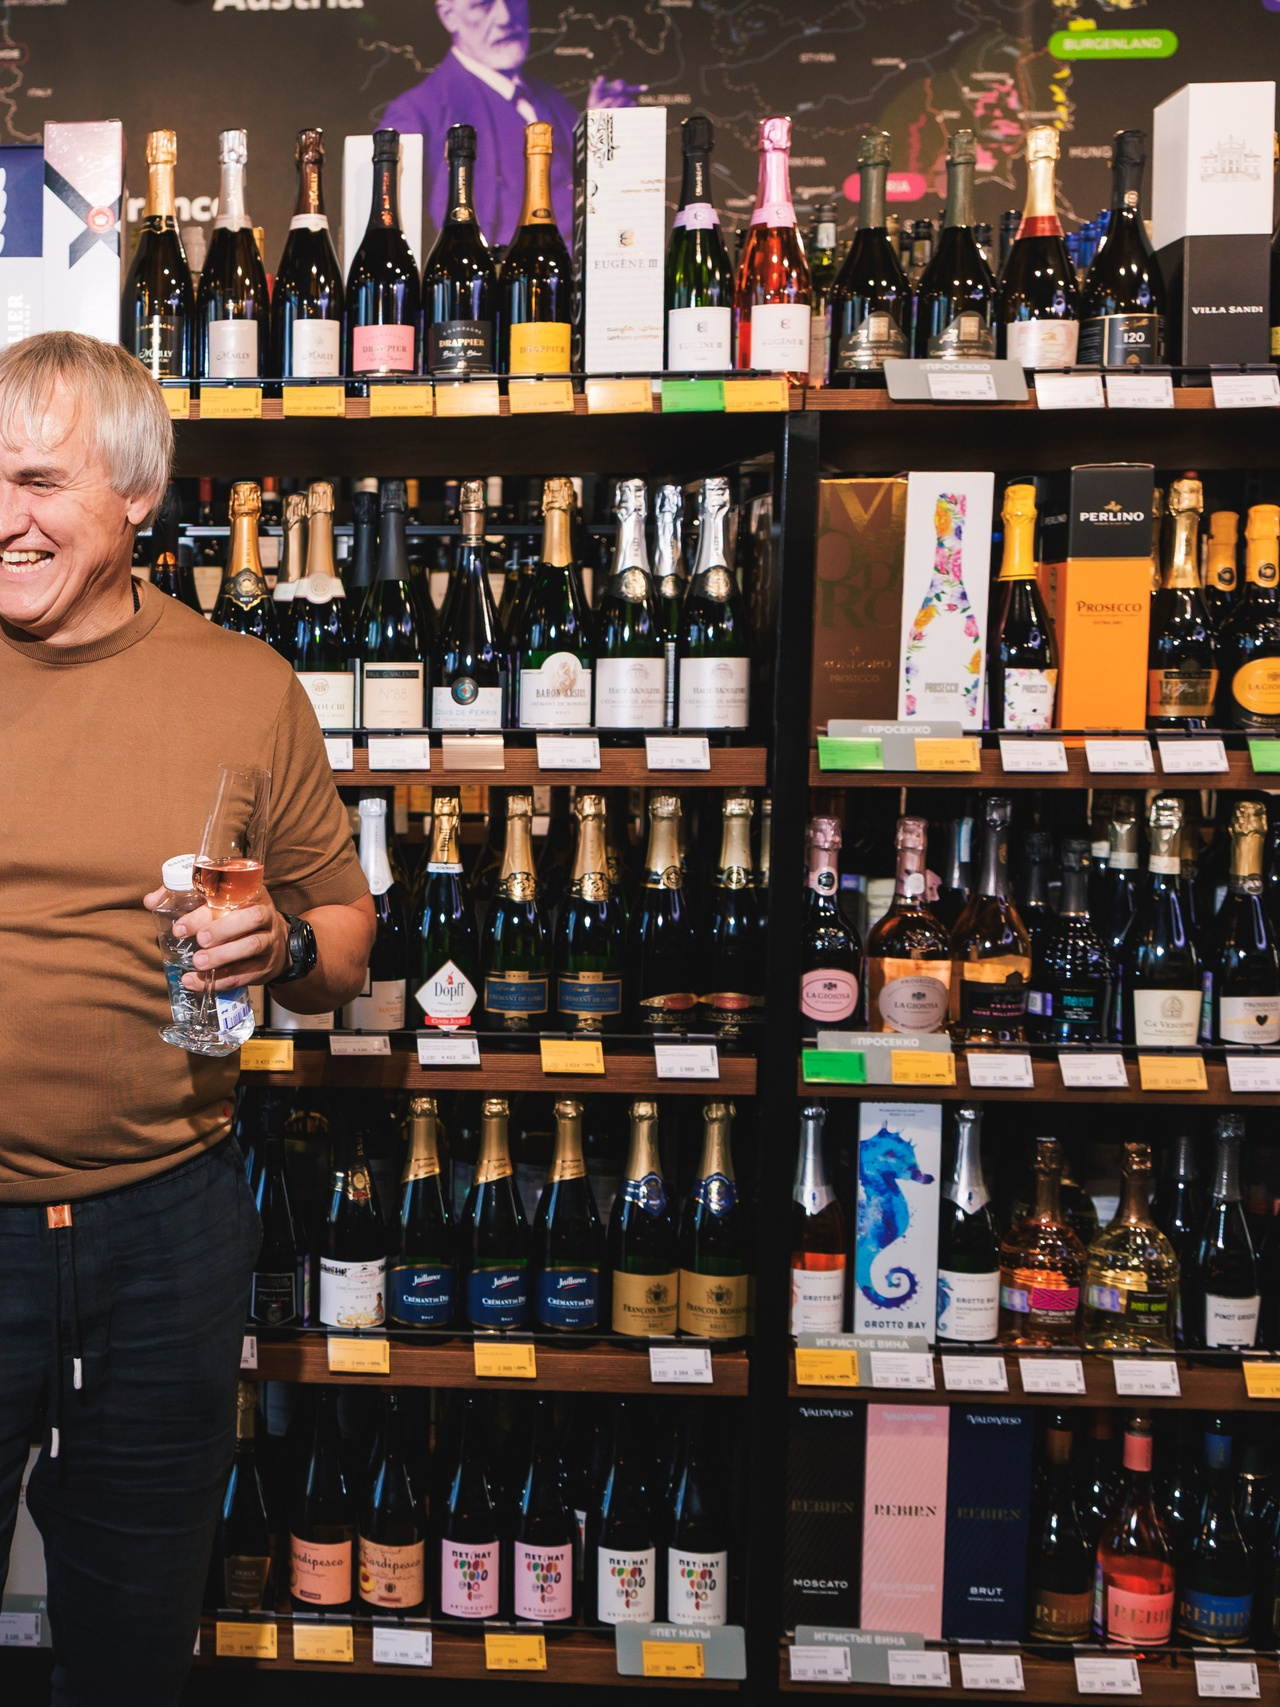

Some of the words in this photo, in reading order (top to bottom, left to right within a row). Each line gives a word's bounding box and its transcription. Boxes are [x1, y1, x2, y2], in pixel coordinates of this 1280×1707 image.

[1062, 36, 1163, 52] BURGENLAND
[594, 257, 645, 270] EUGÈNE
[1191, 306, 1226, 314] VILLA
[1228, 305, 1264, 314] SANDI
[1123, 331, 1146, 343] 120
[362, 344, 407, 353] DRAPPIER
[439, 339, 485, 347] DRAPPIER
[1079, 511, 1145, 522] PERLINO
[1076, 600, 1142, 612] PROSECCO
[536, 688, 562, 698] BARON
[434, 981, 466, 1001] Dopff
[803, 1294, 830, 1302] GROTTO
[623, 1304, 656, 1315] FRANÇOIS
[686, 1302, 718, 1314] FRANÇOIS
[864, 1320, 904, 1329] GROTTO
[907, 1321, 927, 1330] BAY
[815, 1337, 876, 1348] ИГРИСТЫЕ
[877, 1338, 910, 1349] ВИНА
[799, 1407, 853, 1418] VALDIVIESO
[966, 1414, 1022, 1425] VALDIVIESO
[793, 1578, 848, 1589] MOSCATO
[969, 1586, 1003, 1596] BRUT
[813, 1631, 873, 1645] ИГРИСТЫЕ
[874, 1633, 906, 1647] ВИНА
